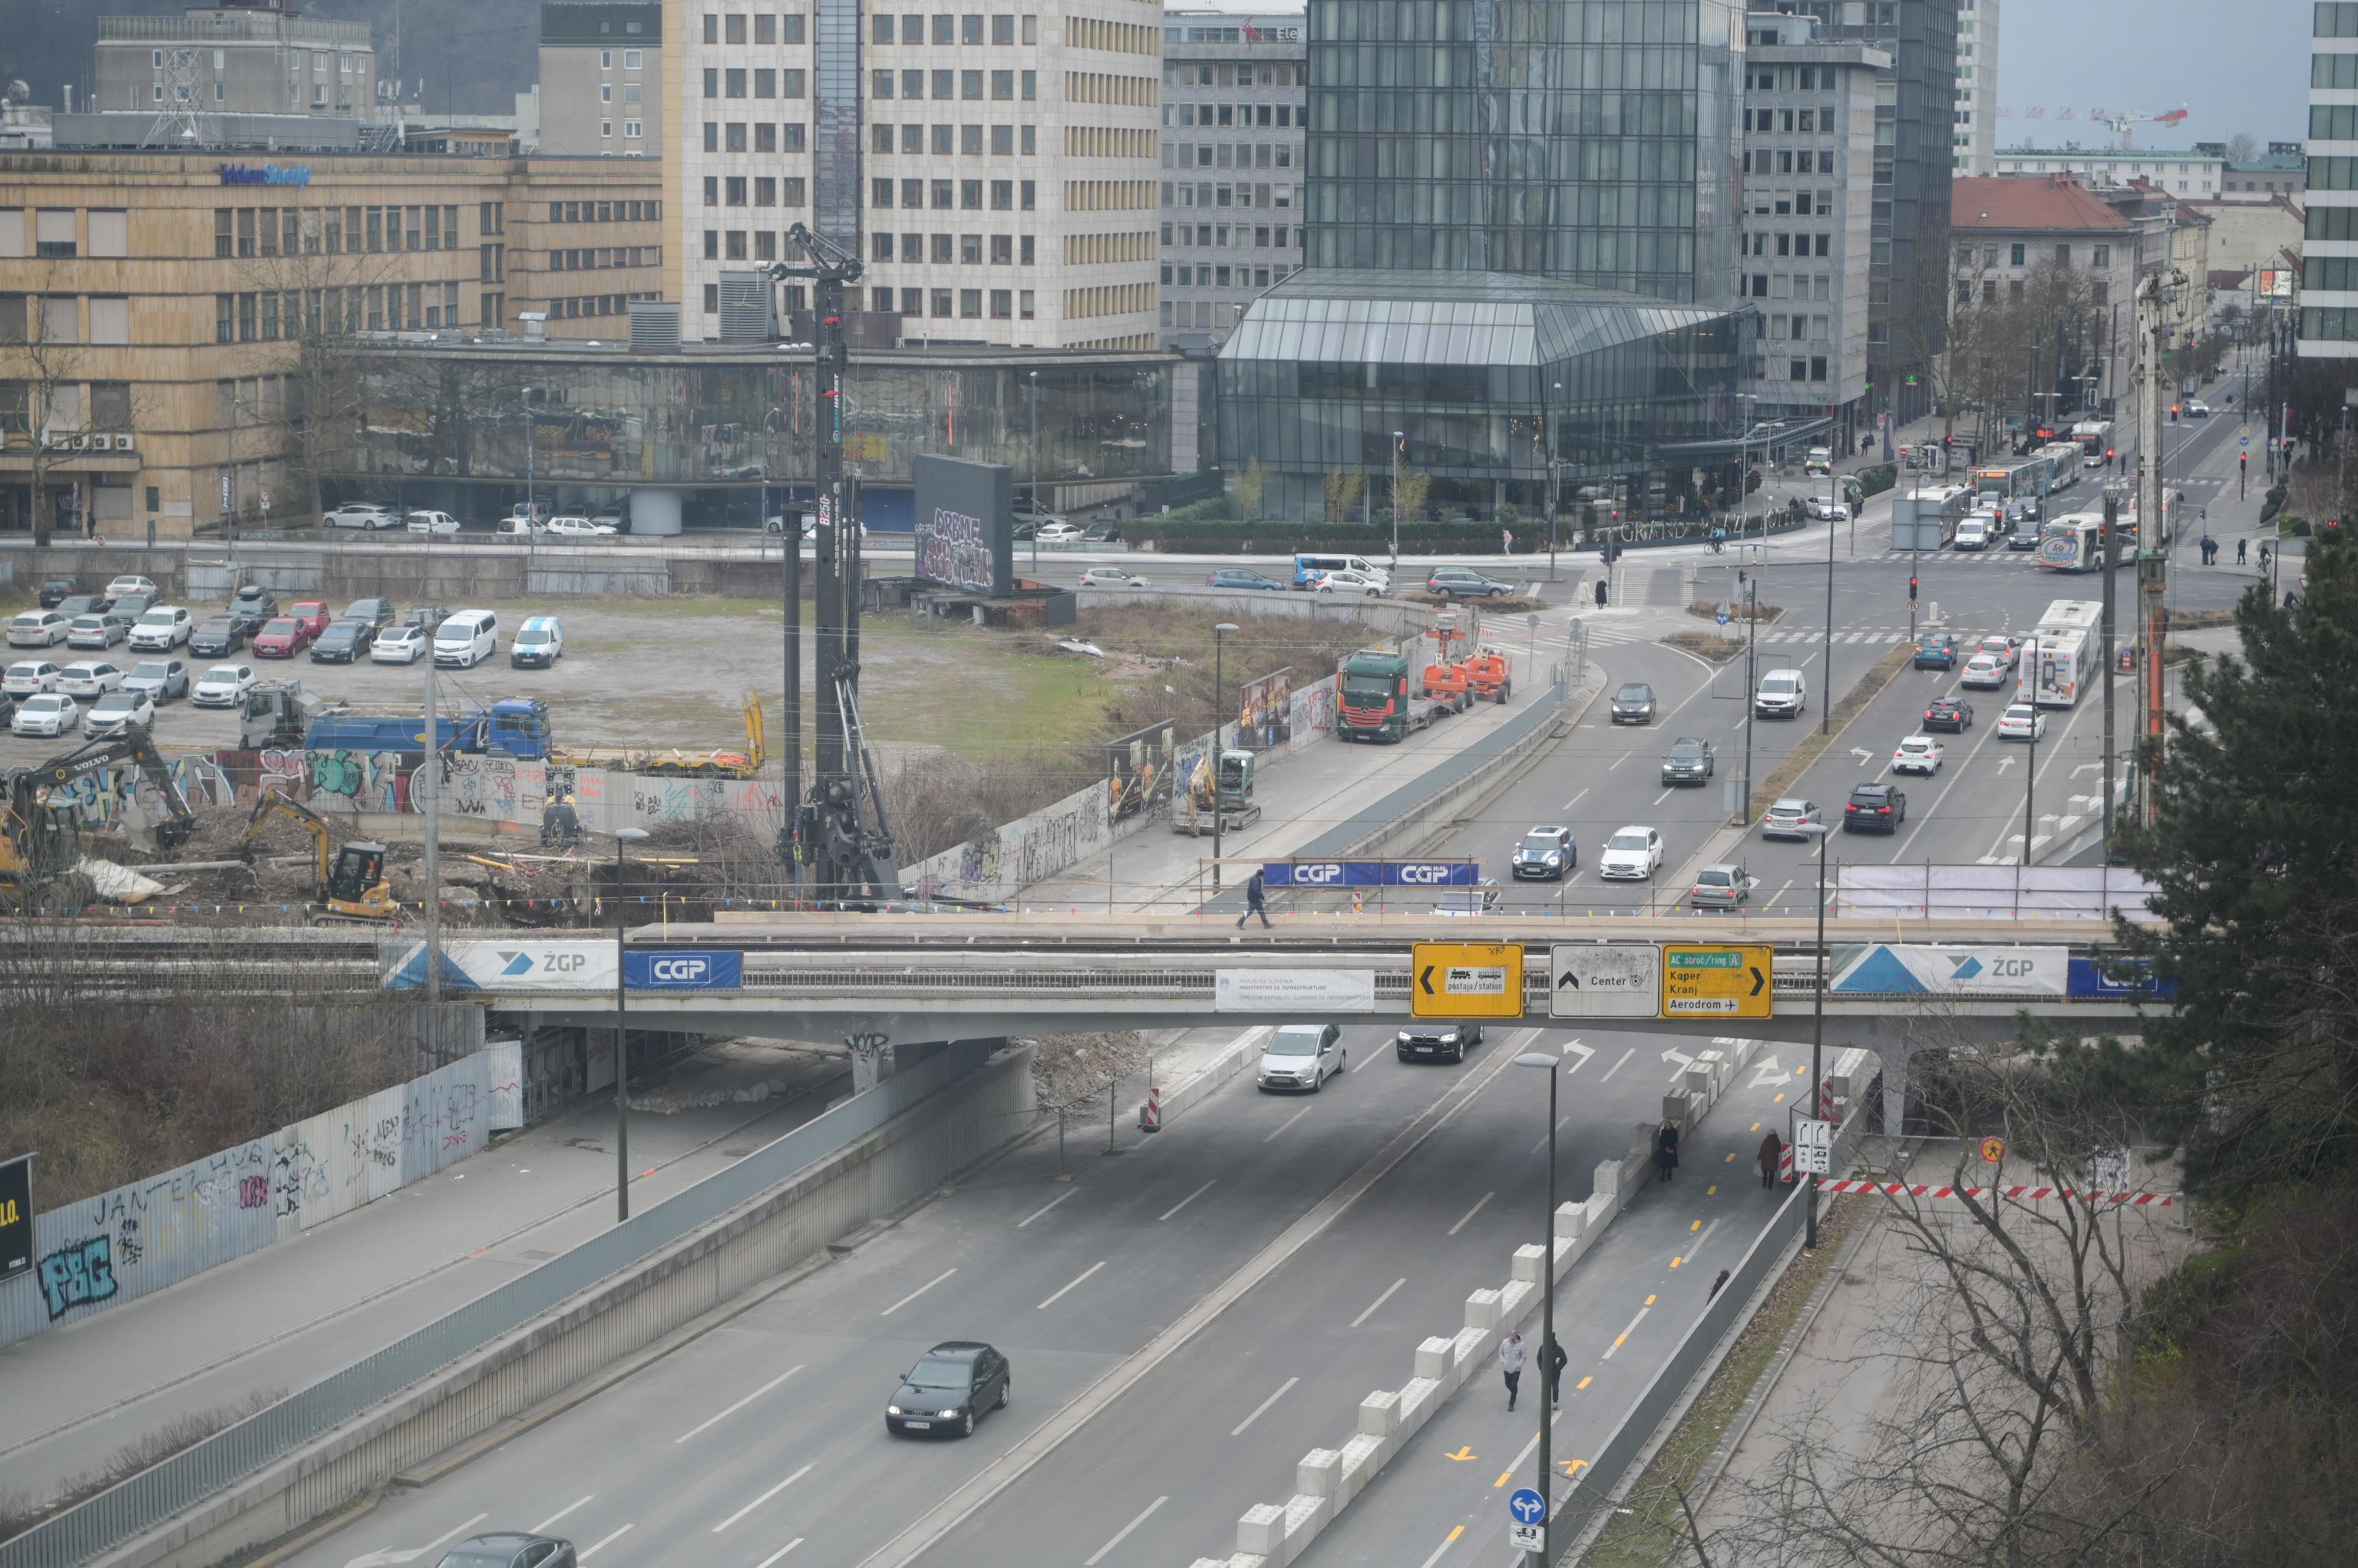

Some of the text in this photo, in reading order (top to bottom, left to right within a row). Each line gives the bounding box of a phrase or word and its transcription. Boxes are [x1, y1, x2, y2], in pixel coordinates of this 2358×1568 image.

[1620, 520, 1688, 542] GRAND
[74, 754, 109, 771] VOLVO
[1295, 865, 1340, 882] CGP
[1402, 867, 1448, 883] CGP
[543, 951, 585, 972] ŽGP
[1670, 956, 1680, 965] AC
[1992, 956, 2033, 977] ŽGP
[654, 960, 706, 979] CGP
[1670, 971, 1701, 982] Koper
[1591, 976, 1626, 986] Center
[1670, 985, 1698, 996] Kranj
[1670, 1000, 1722, 1008] Aerodrom
